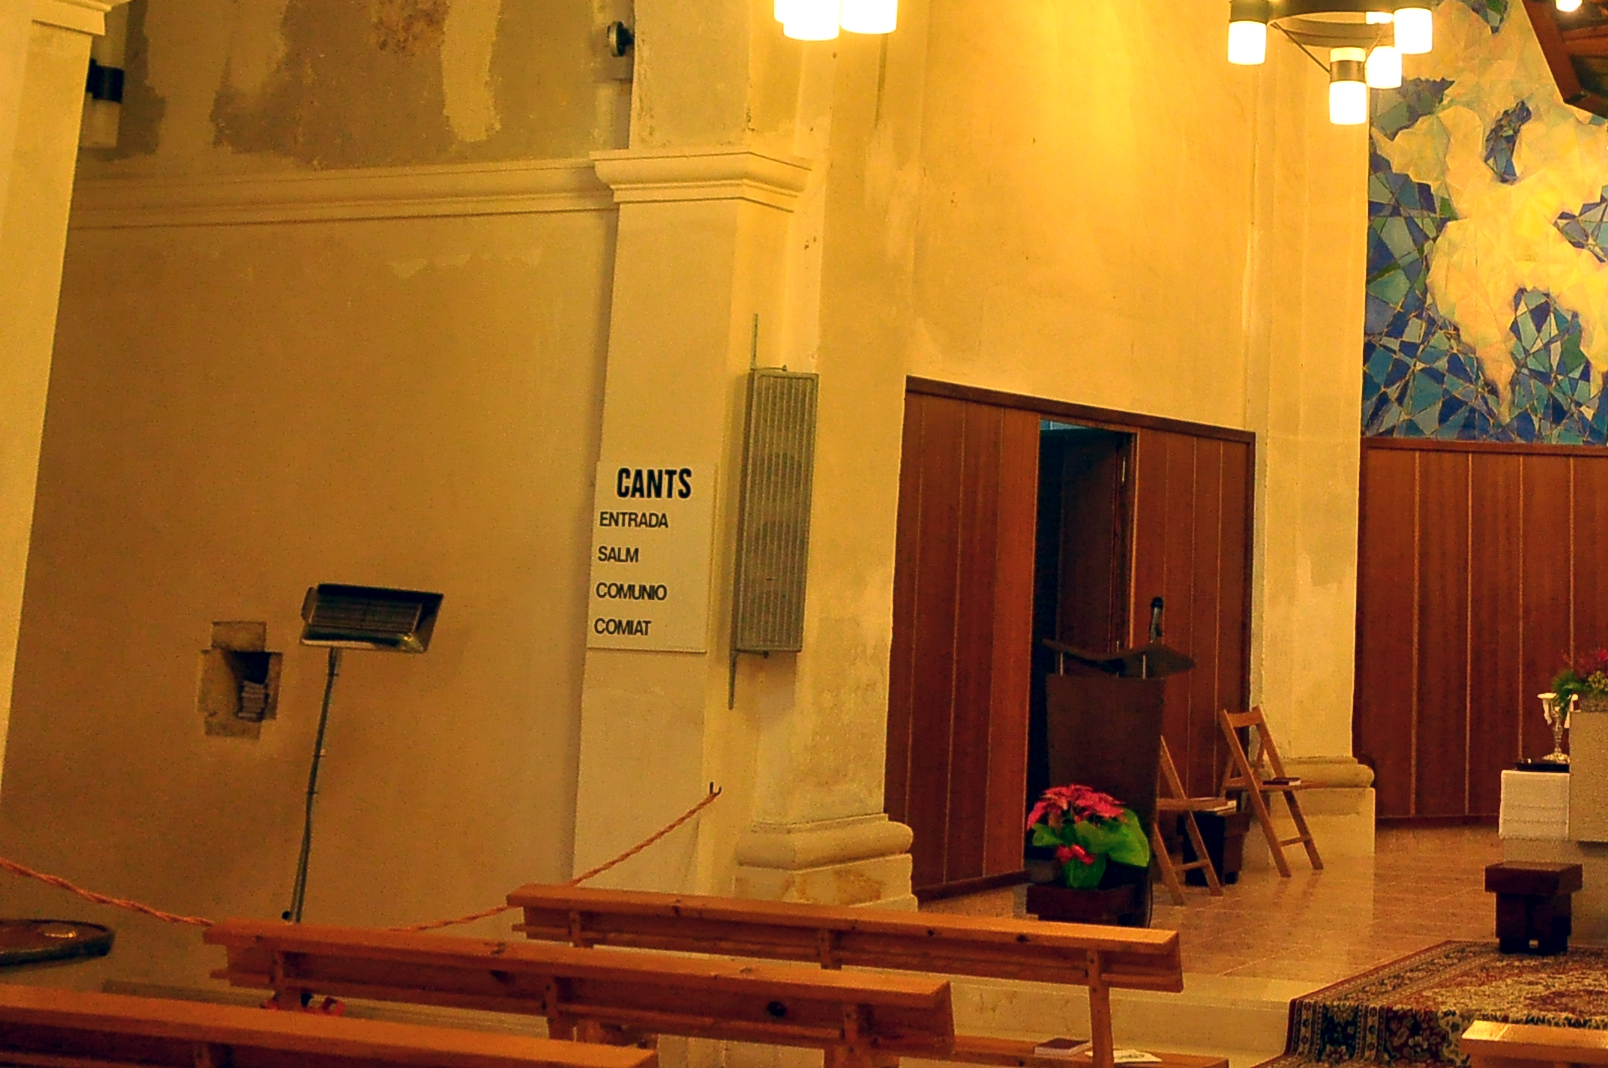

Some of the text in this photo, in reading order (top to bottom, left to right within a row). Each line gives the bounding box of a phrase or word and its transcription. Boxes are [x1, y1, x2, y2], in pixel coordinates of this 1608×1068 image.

[617, 467, 692, 498] CANTS
[599, 511, 669, 528] ENTRADA
[597, 545, 639, 562] SALM
[595, 582, 667, 600] COMUNIO
[594, 618, 652, 635] COMIAT
